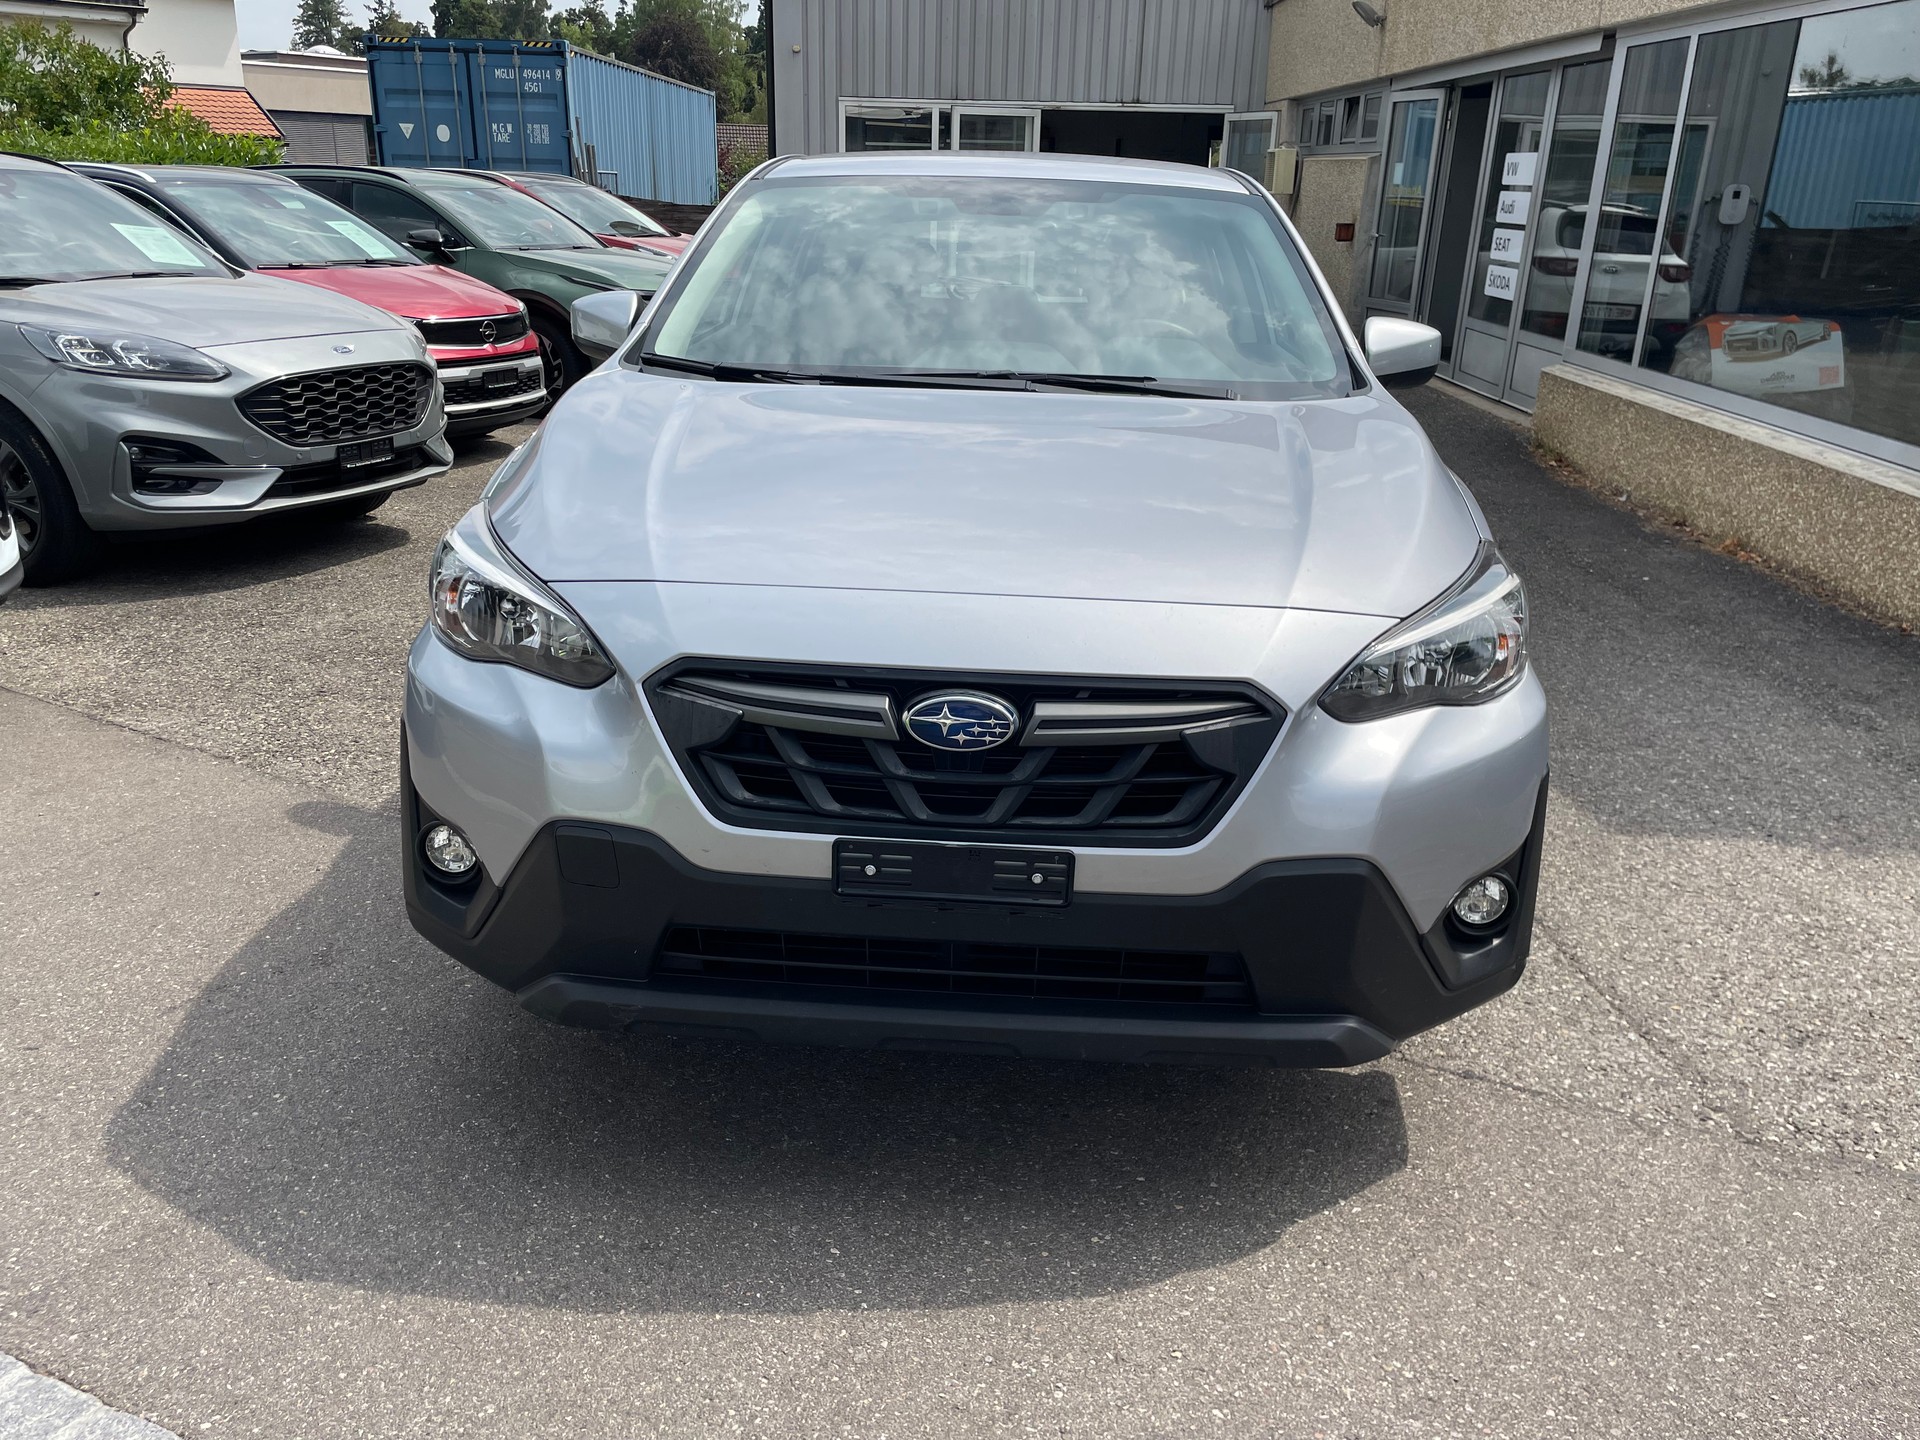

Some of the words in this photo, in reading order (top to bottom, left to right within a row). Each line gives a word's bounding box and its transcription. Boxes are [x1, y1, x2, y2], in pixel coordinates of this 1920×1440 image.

[494, 68, 515, 79] MGLU
[522, 69, 551, 80] 496414
[524, 82, 542, 93] 45G1
[493, 133, 511, 143] TARE
[1506, 161, 1520, 176] VW
[1500, 200, 1516, 215] Audi
[1494, 236, 1511, 252] SEAT
[1488, 269, 1511, 292] ŠKODA
